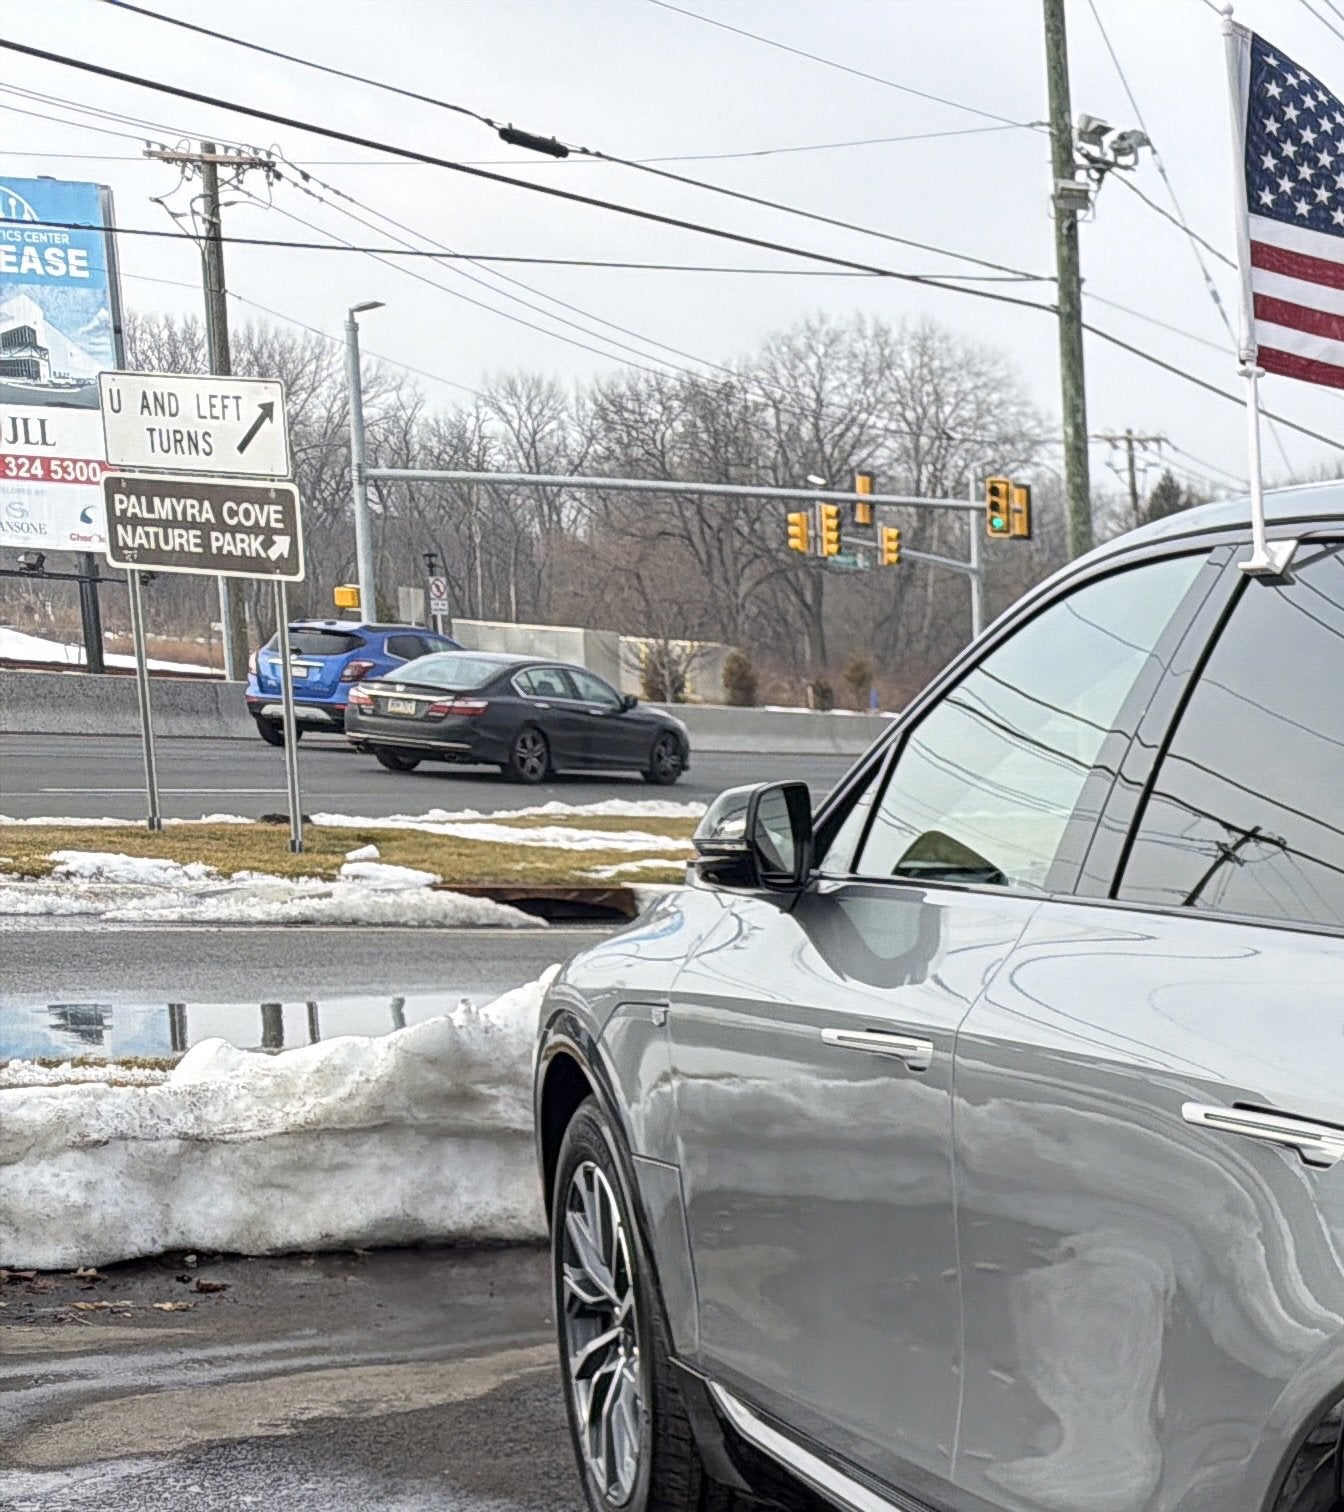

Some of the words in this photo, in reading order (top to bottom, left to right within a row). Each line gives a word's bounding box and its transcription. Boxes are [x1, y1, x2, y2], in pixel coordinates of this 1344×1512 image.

[0, 230, 21, 241] ICS
[24, 231, 70, 244] CENTER
[0, 245, 90, 277] EASE
[109, 388, 122, 413] U
[140, 390, 179, 418] AND
[196, 393, 242, 421] LEFT
[5, 416, 56, 446] JLL
[146, 427, 213, 456] TURNS
[5, 457, 44, 478] 324
[50, 459, 100, 482] 5300
[114, 494, 216, 523] PALMYRA
[222, 501, 284, 528] COVE
[117, 524, 203, 552] NATURE
[210, 531, 267, 558] PARK
